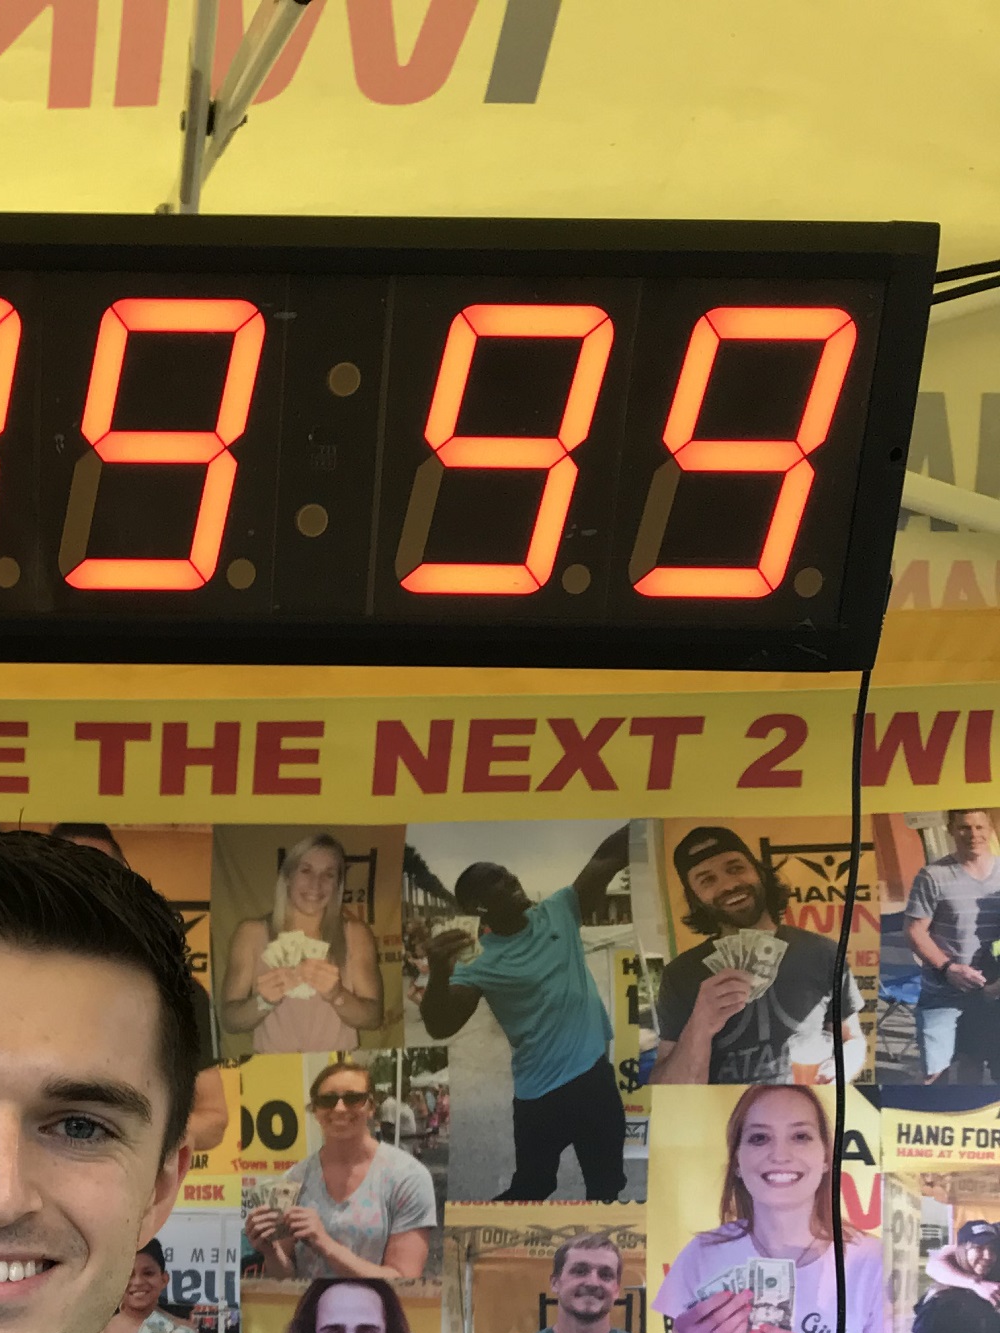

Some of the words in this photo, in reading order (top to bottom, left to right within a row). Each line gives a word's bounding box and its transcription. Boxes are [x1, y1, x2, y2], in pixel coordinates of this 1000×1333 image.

[74, 719, 326, 797] THE
[371, 715, 706, 797] NEXT
[737, 713, 810, 790] 2
[897, 1123, 954, 1146] HANG
[184, 1184, 226, 1201] RISK
